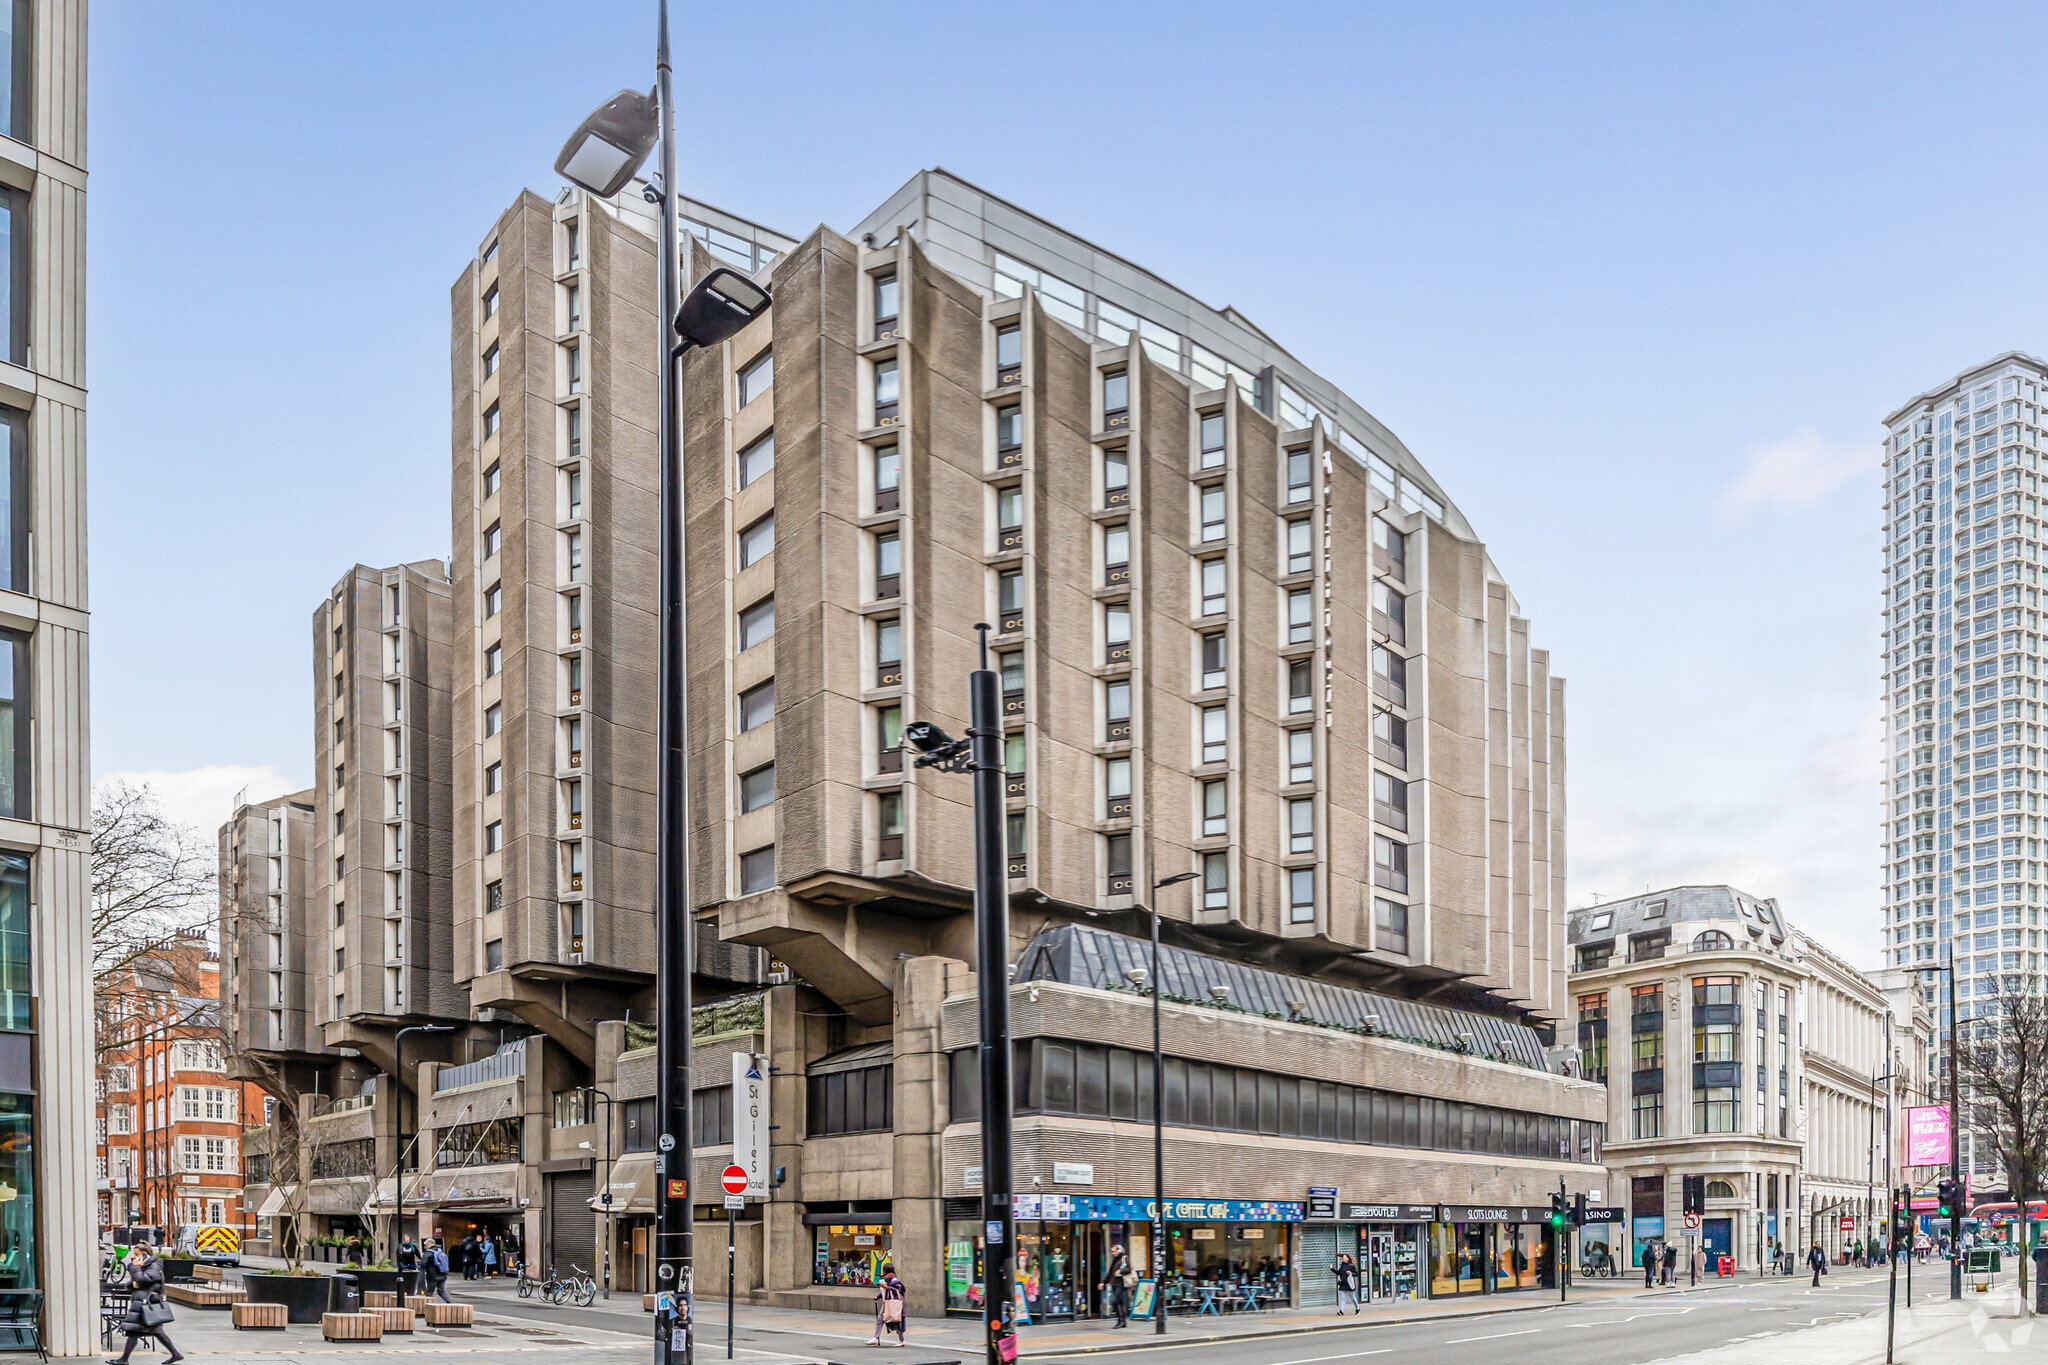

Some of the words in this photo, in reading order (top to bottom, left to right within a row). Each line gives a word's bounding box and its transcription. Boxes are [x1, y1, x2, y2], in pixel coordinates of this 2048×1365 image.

[748, 1084, 759, 1099] St
[1467, 1209, 1484, 1220] SLOTS
[1485, 1209, 1508, 1220] LOUNGE
